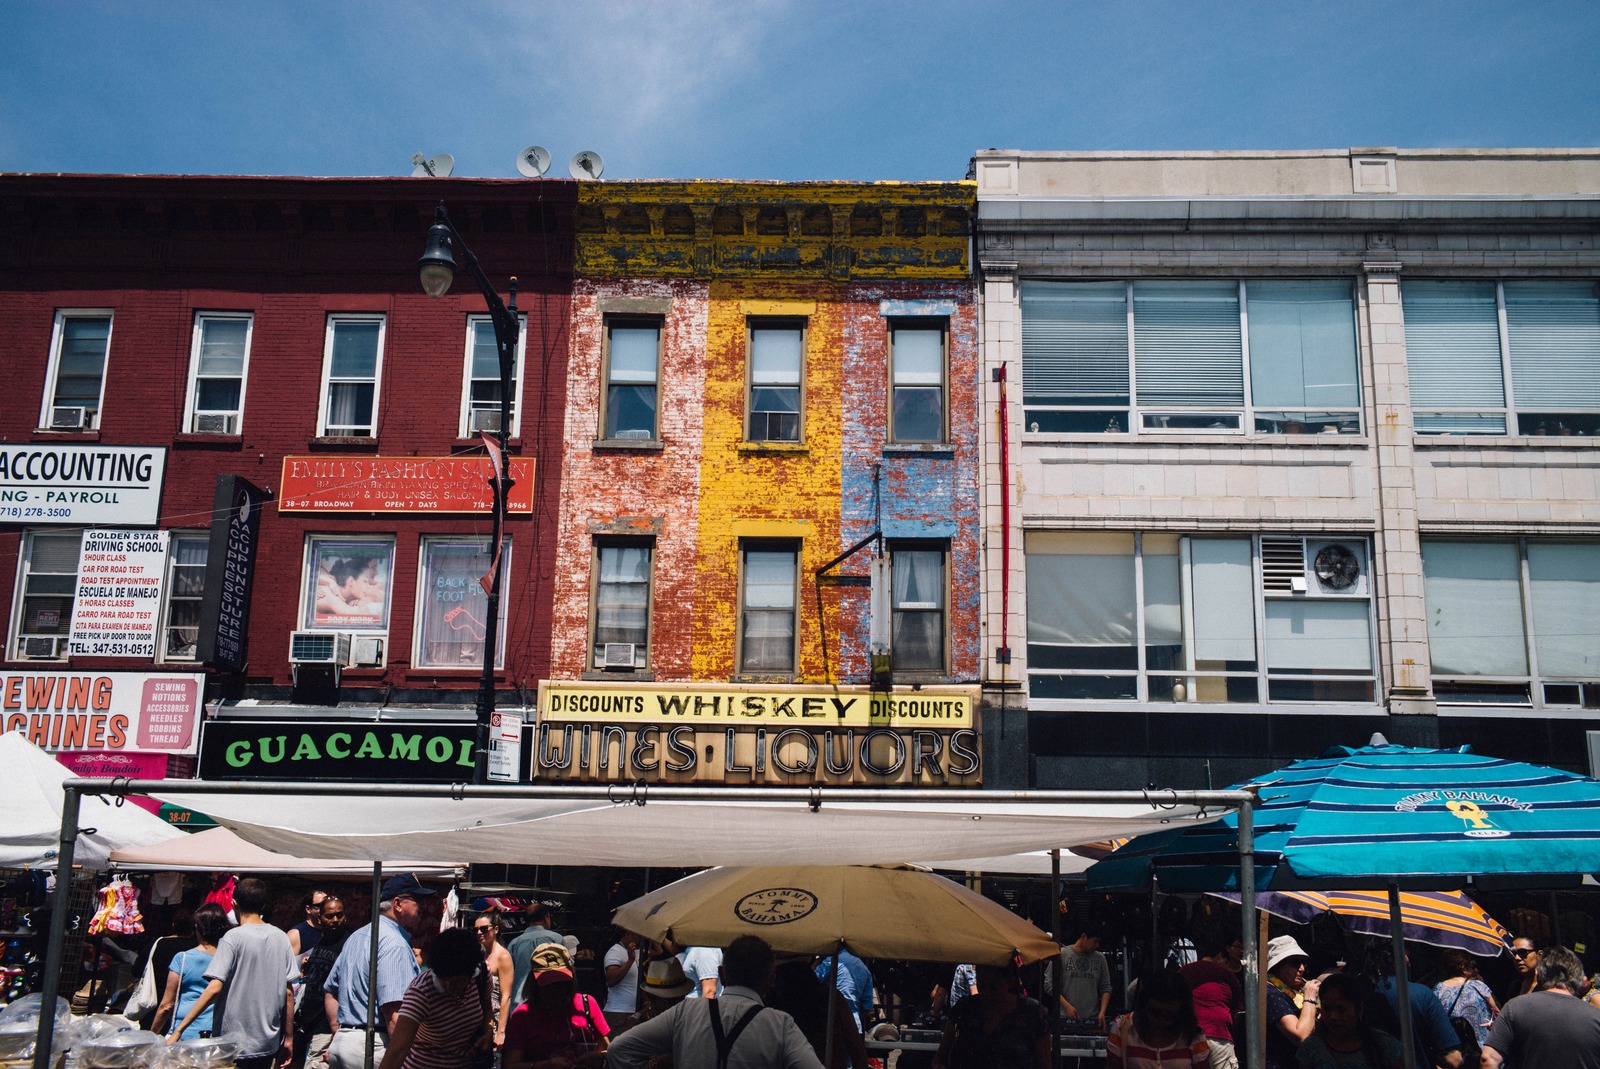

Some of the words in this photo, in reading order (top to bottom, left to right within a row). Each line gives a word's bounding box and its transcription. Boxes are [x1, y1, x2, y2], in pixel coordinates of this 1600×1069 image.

[0, 451, 153, 482] ACCOUNTING
[290, 461, 363, 479] EMILY'S
[369, 462, 455, 479] FASHION
[370, 480, 396, 489] BIKINI
[400, 481, 439, 489] WAXING
[443, 481, 492, 490] SPECIALIS
[46, 491, 119, 504] PAYROLL
[337, 490, 360, 499] HAIR
[364, 490, 370, 499] &
[375, 490, 401, 499] BODY
[405, 491, 439, 499] UNISEX
[443, 491, 475, 500] SALON
[24, 507, 71, 518] 278-3500
[90, 532, 130, 540] GOLDEN
[85, 541, 124, 552] DRIVING
[126, 541, 164, 553] SCHOOL
[106, 554, 127, 562] CLASS
[129, 566, 144, 574] TEST
[100, 577, 115, 585] TEST
[116, 577, 160, 585] APPOINTMENT
[218, 518, 241, 636] ACUPRESSURE
[228, 524, 251, 640] ACUPUNCTURE
[437, 576, 467, 588] BACK
[79, 587, 113, 598] ESCUELA
[115, 587, 125, 598] DE
[127, 588, 159, 598] MANEJO
[436, 591, 465, 602] FOOT
[107, 600, 135, 608] CLASSES
[117, 611, 135, 619] ROAD
[75, 622, 87, 630] CITA
[131, 623, 153, 631] MANEJO
[88, 632, 101, 640] PICK
[102, 632, 110, 640] UP
[136, 633, 152, 641] DOOR
[70, 643, 90, 653] TEL:
[92, 643, 153, 655] 347-531-0512
[155, 683, 186, 691] SEWING
[0, 676, 113, 710] EWING
[151, 693, 187, 702] NOTIONS
[146, 704, 190, 712] ACCESSORIES
[551, 694, 644, 713] DISCOUNTS
[657, 694, 858, 718] WHISKEY
[869, 700, 964, 719] DISCOUNTS
[150, 714, 183, 723] NEEDLES
[0, 713, 129, 749] CHINES
[149, 724, 182, 733] BOBBINS
[150, 734, 179, 743] THREAD
[225, 731, 476, 768] GUACAMOL
[539, 723, 698, 771] WINES
[725, 728, 980, 775] LIQUORS
[101, 764, 143, 774] Boudoir
[1441, 790, 1535, 813] BAHAMA
[168, 812, 191, 822] 38-07
[755, 890, 810, 902] TOMMY
[742, 907, 805, 922] BAHAMA
